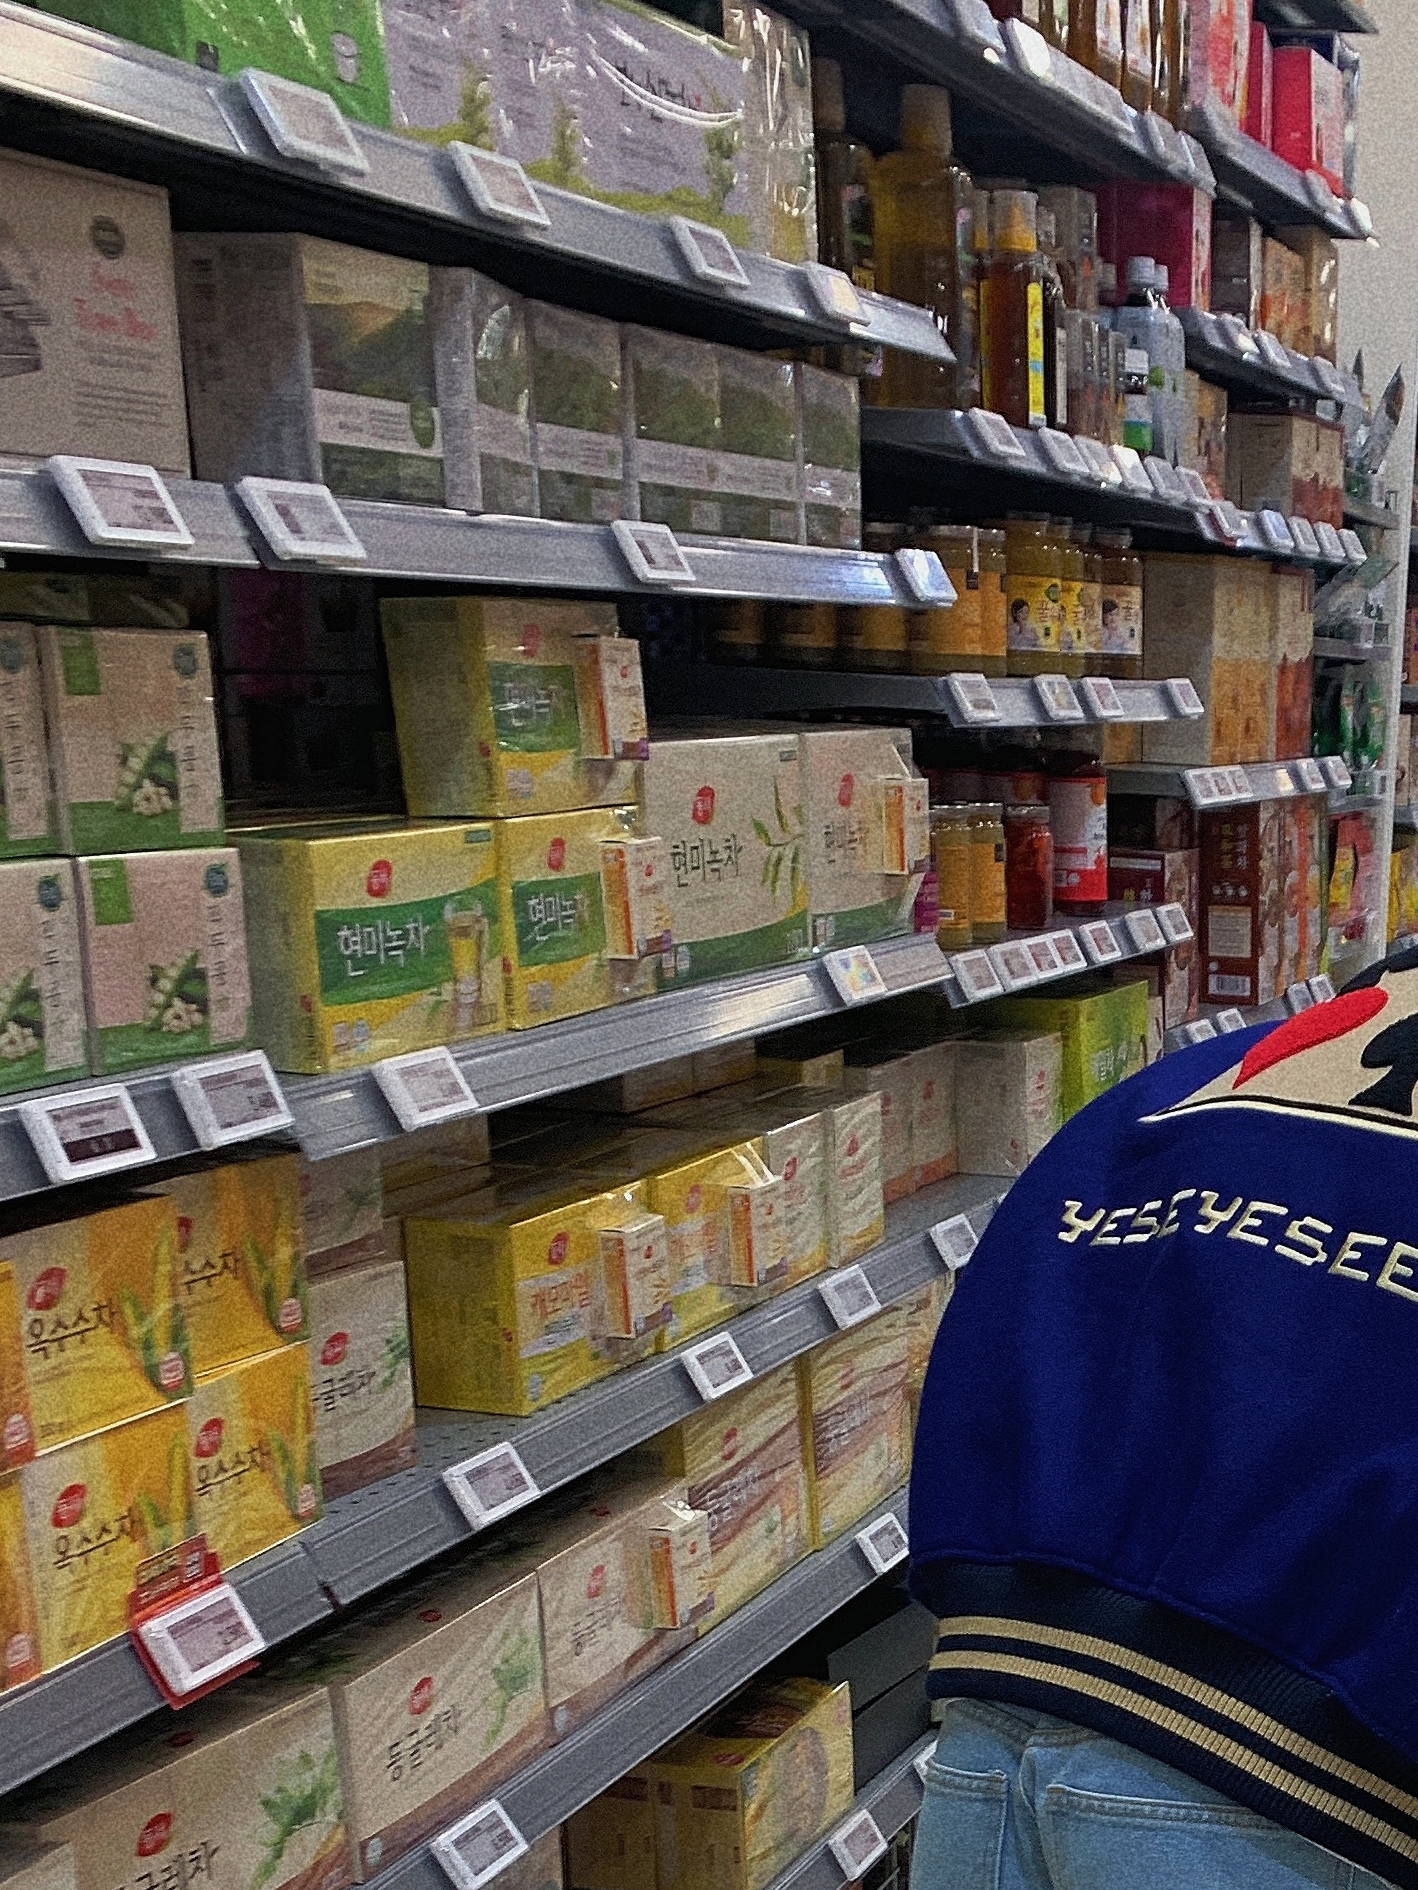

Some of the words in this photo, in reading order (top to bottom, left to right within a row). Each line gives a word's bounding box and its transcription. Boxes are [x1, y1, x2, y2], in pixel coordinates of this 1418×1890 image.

[669, 833, 743, 888] 현미녹차
[337, 913, 429, 977] 현미녹차
[26, 1298, 117, 1360] 옥수수차
[195, 1439, 271, 1498] 옥수수차
[53, 1506, 142, 1570] 옥수수차
